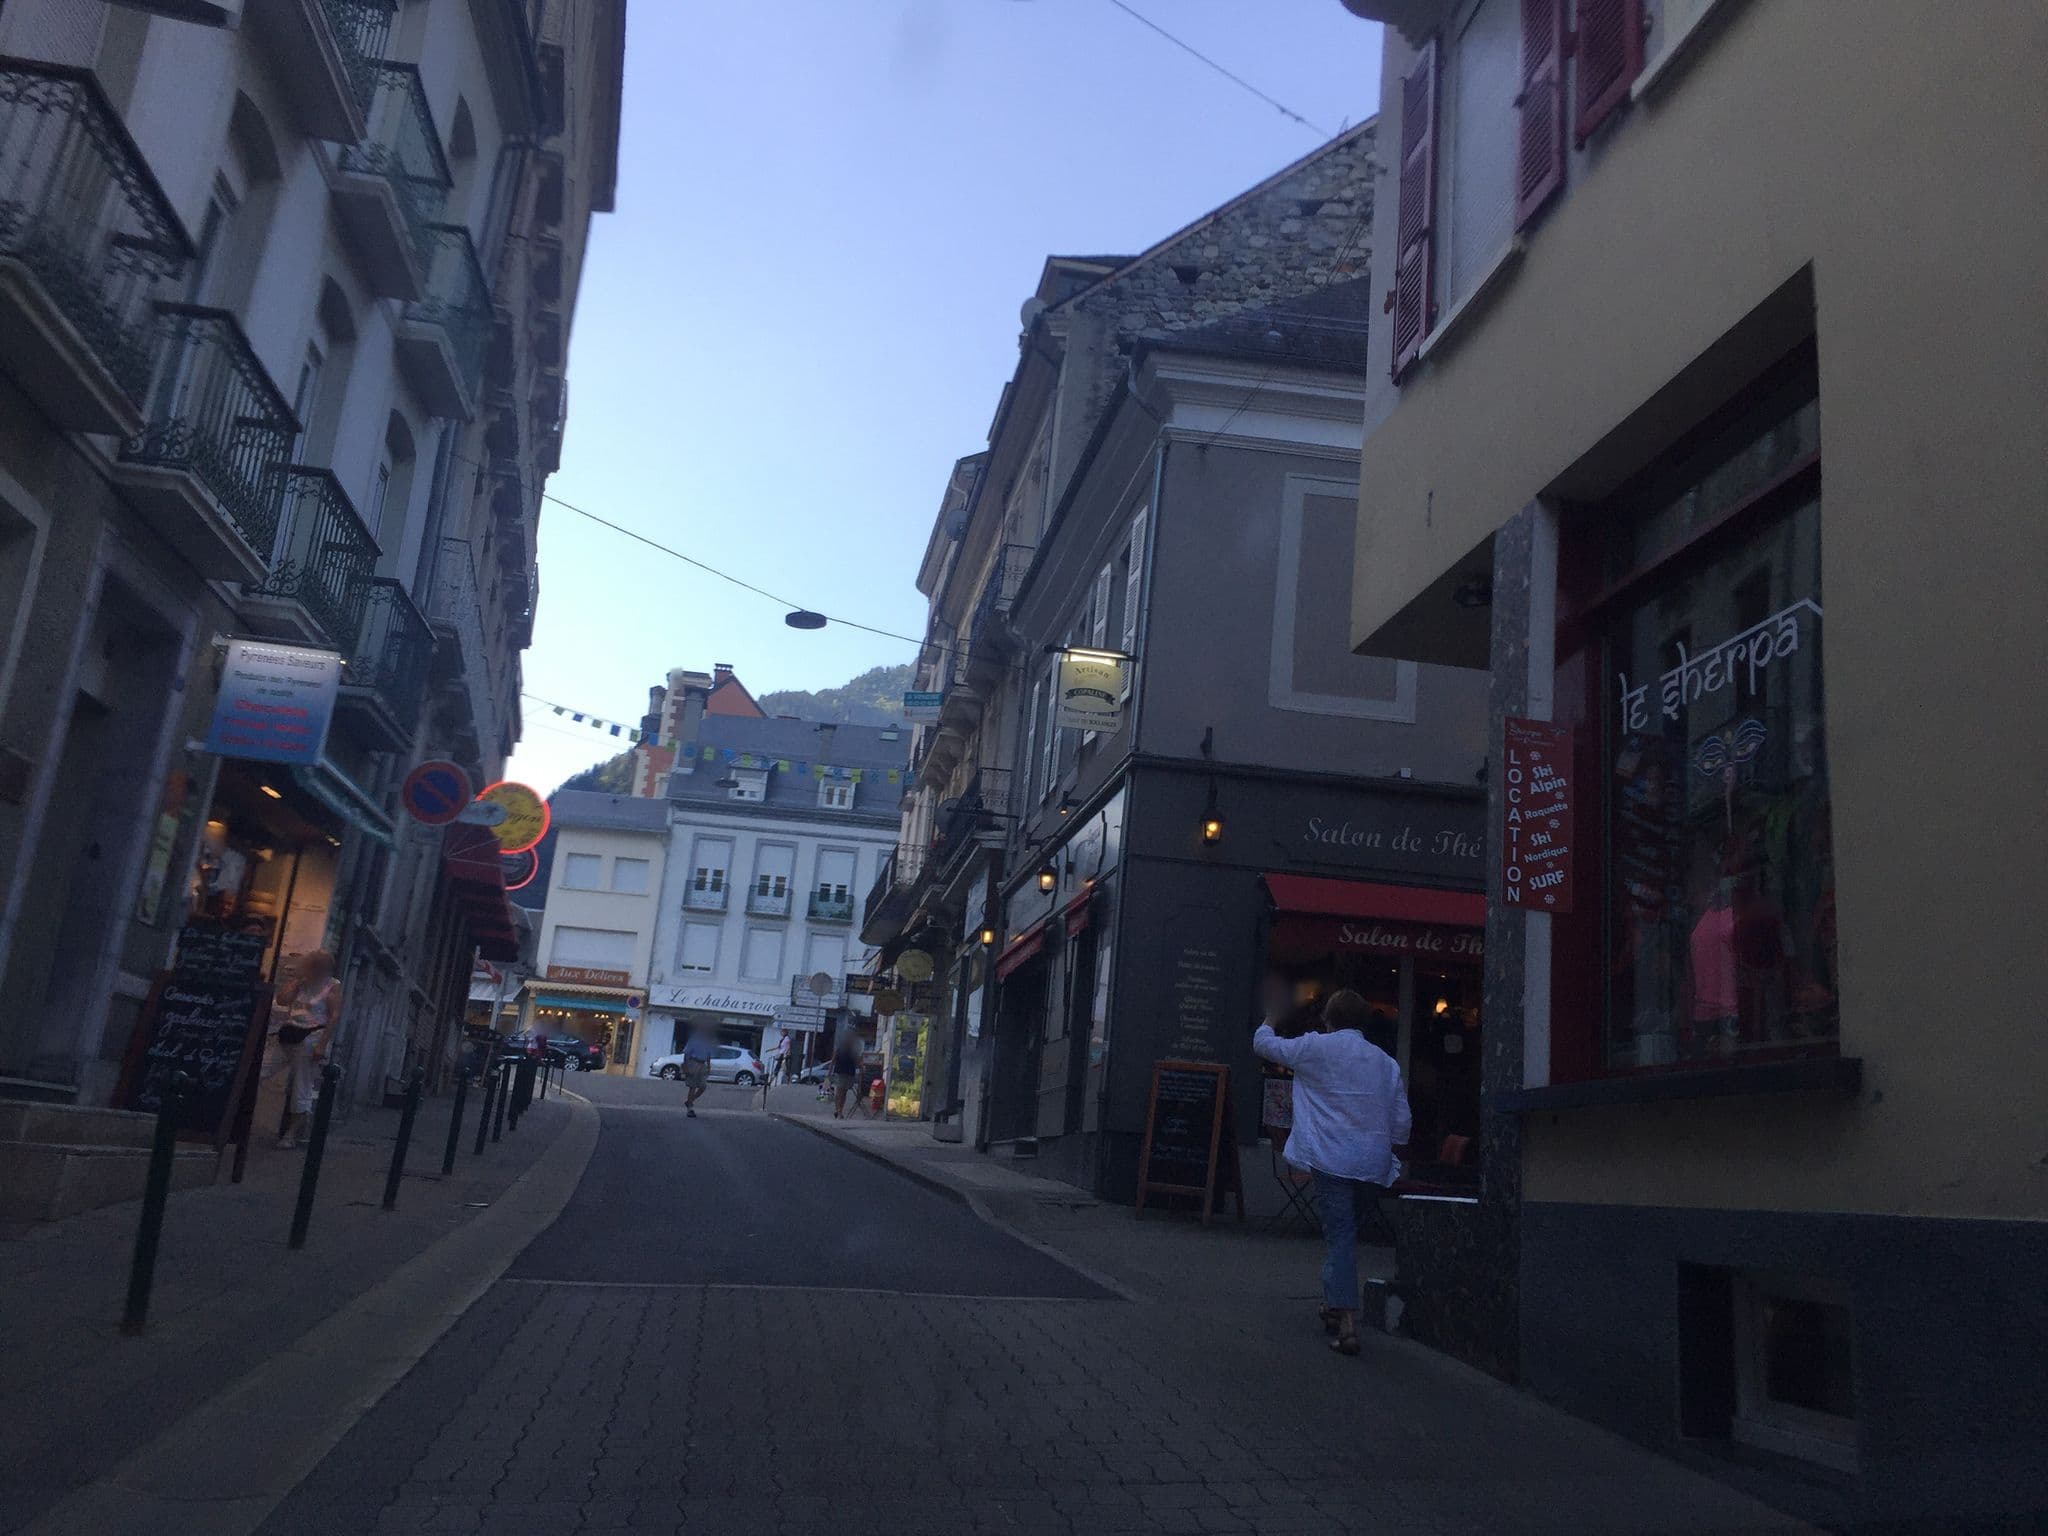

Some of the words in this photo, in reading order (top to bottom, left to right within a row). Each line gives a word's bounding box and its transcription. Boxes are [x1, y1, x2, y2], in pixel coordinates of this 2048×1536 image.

[1074, 665, 1110, 679] Artisan
[1531, 764, 1554, 780] Ski
[1530, 777, 1567, 795] Alpin
[1507, 749, 1522, 902] LOCATION
[1304, 817, 1381, 848] Salon
[1392, 826, 1422, 852] de
[1431, 829, 1483, 858] Thé
[1530, 831, 1553, 847] Ski
[1523, 846, 1569, 864] Nordique
[1529, 869, 1565, 891] SURF
[1338, 923, 1409, 948] Salon
[1416, 930, 1443, 951] de
[584, 968, 625, 984] Délices
